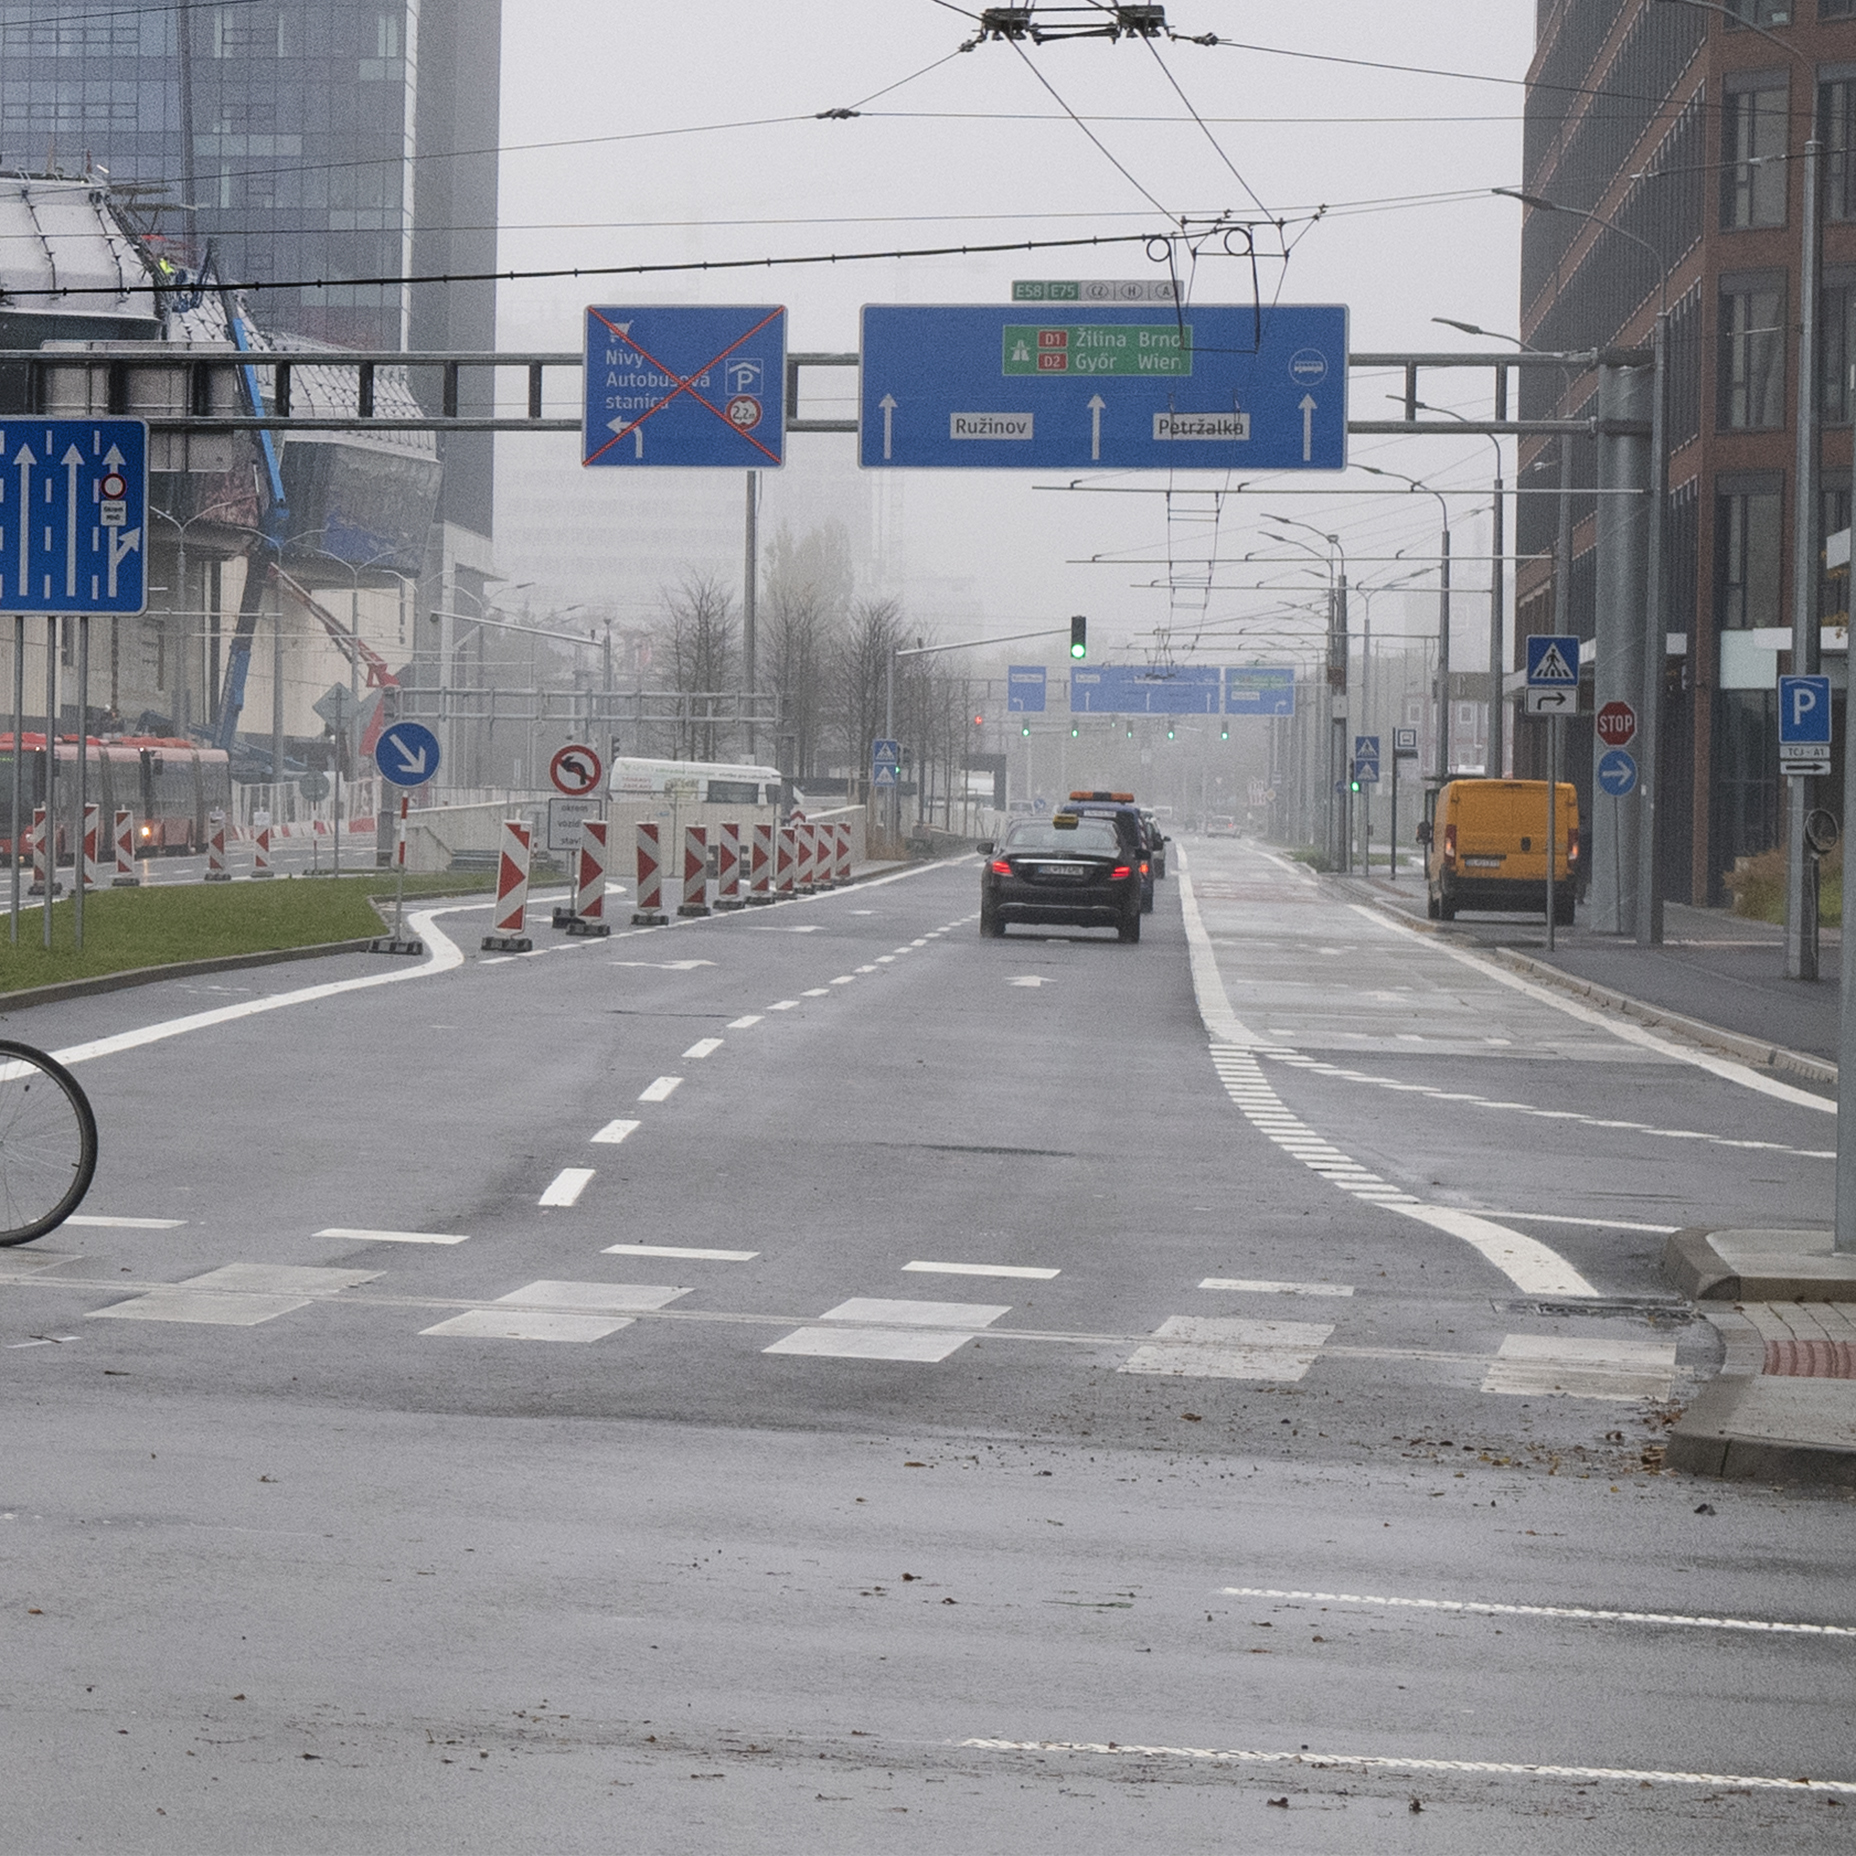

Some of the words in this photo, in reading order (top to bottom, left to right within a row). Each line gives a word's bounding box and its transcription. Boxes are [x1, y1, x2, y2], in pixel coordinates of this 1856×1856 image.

[1016, 284, 1042, 298] E58
[1051, 284, 1075, 298] E75
[1128, 286, 1136, 296] H
[1162, 286, 1170, 296] A
[1045, 333, 1061, 345] D1
[1076, 327, 1127, 348] Žilina
[1139, 331, 1184, 348] Brno
[606, 348, 644, 369] Nivy
[1044, 355, 1060, 368] D2
[1076, 353, 1117, 372] Győr
[1139, 354, 1182, 370] Wien
[955, 417, 1027, 435] Ružinov
[1158, 418, 1244, 435] Petržalka
[1598, 714, 1634, 733] STOP
[561, 804, 588, 813] okrem
